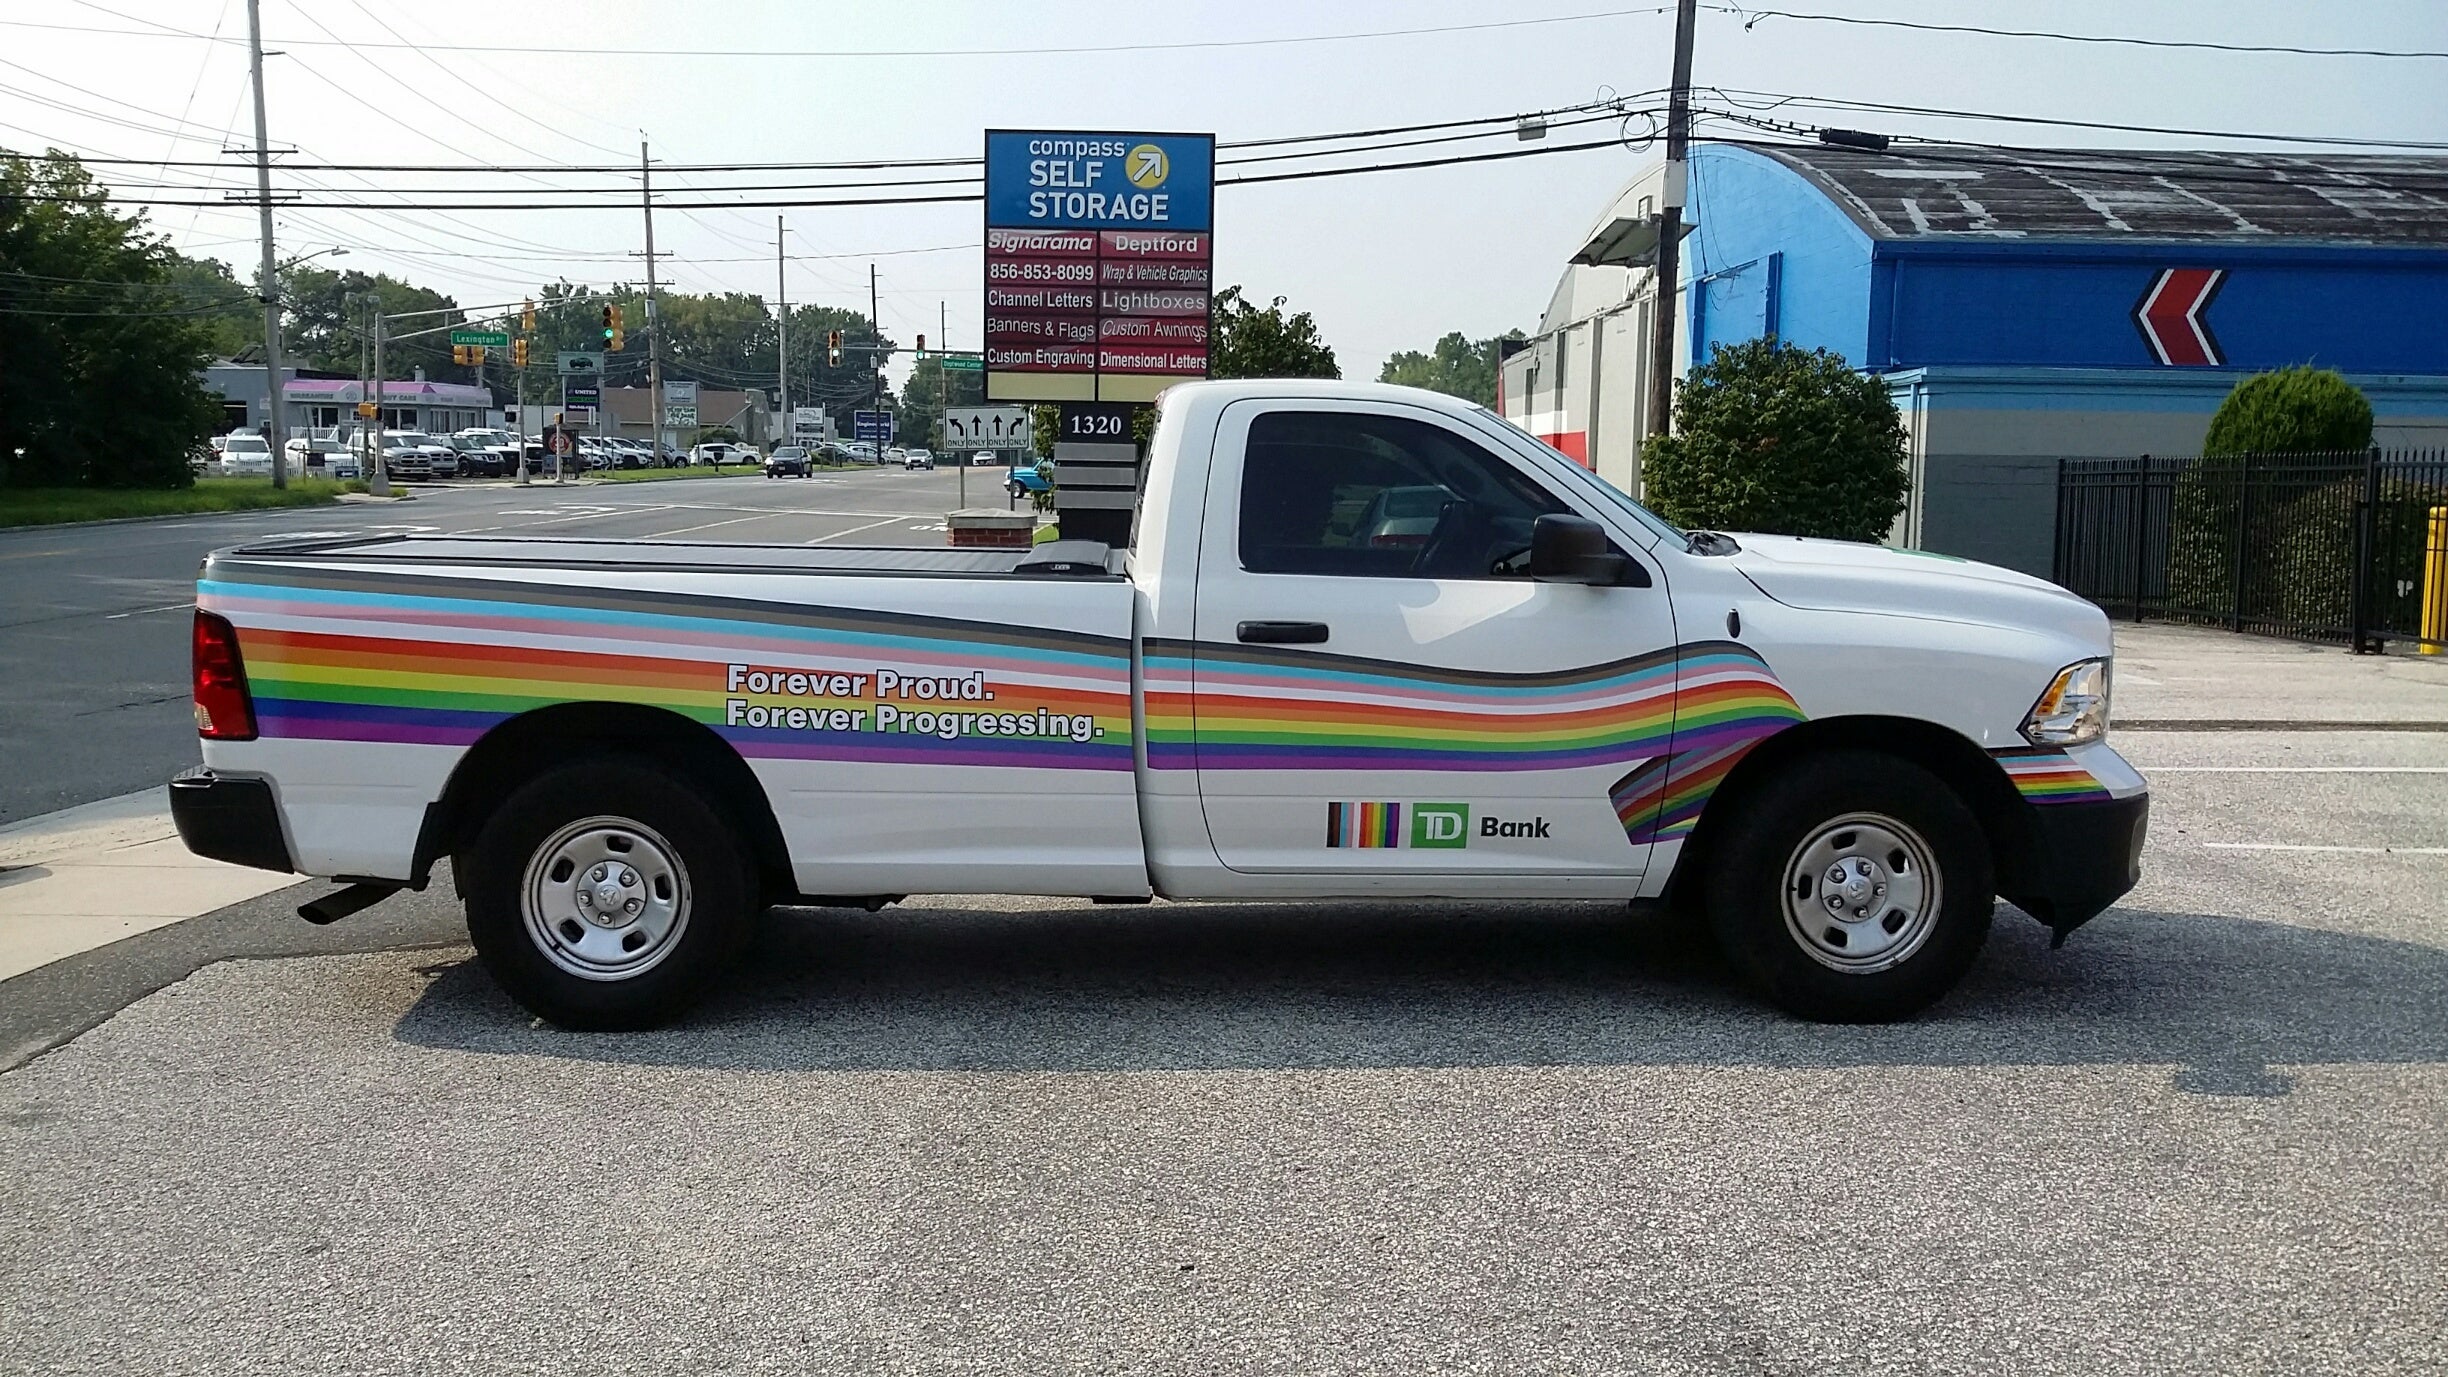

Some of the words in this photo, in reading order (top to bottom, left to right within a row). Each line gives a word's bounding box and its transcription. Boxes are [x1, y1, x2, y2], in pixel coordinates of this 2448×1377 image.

[1029, 140, 1125, 161] compass
[1029, 159, 1104, 188] SELF
[1028, 191, 1169, 221] STORAGE
[988, 233, 1093, 253] Signarama
[1116, 236, 1198, 255] Deptford
[990, 263, 1094, 281] 856-853-8099
[1103, 264, 1124, 283] Wrap
[1127, 264, 1134, 280] &
[1136, 265, 1167, 281] Vehicle
[1169, 266, 1208, 284] Graphics
[988, 289, 1043, 307] Channel
[1047, 291, 1093, 308] Letters
[1102, 291, 1206, 312] Lightboxes
[987, 317, 1041, 335] Banners
[1045, 320, 1055, 337] &
[1059, 321, 1095, 341] Flags
[1102, 320, 1150, 336] Custom
[1154, 321, 1208, 343] Awnings
[456, 335, 495, 344] Lexington
[987, 348, 1032, 364] Custom
[1036, 349, 1095, 369] Engraving
[1100, 351, 1167, 369] Dimensional
[1170, 354, 1207, 370] Letters
[1071, 415, 1122, 435] 1320
[947, 439, 966, 447] ONLY
[968, 439, 986, 447] ONLY
[988, 439, 1007, 447] ONLY
[1009, 438, 1028, 447] ONLY
[726, 664, 867, 698] Forever
[876, 669, 995, 700] Proud.
[726, 699, 867, 733] Forever
[875, 704, 1104, 742] Progressing.
[1417, 811, 1463, 840] TD
[1480, 816, 1551, 838] Bank
